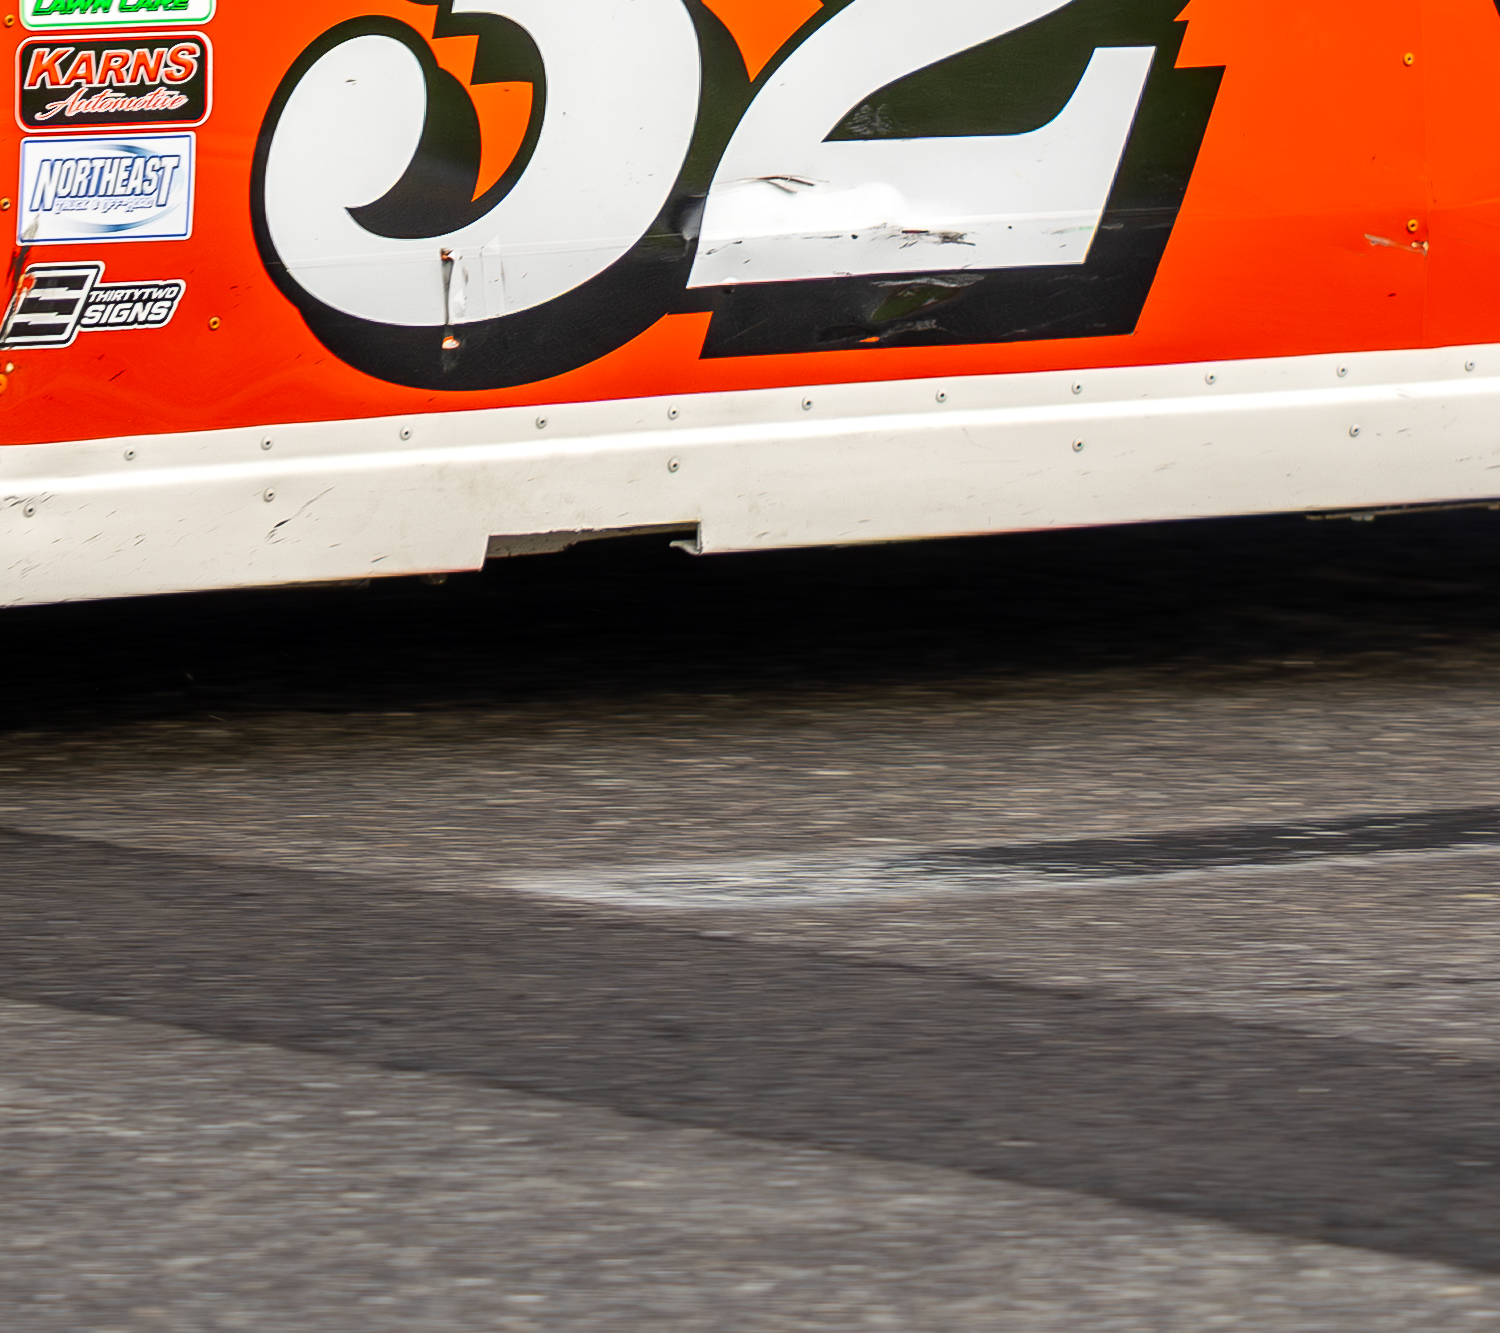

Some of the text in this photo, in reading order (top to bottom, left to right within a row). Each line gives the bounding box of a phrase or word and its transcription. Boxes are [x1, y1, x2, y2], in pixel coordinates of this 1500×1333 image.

[23, 41, 200, 90] KARNS
[34, 86, 189, 121] Automotive
[29, 154, 181, 213] NORTHEAST
[88, 286, 180, 303] THIRTYTWO
[80, 300, 173, 325] SIGNS
